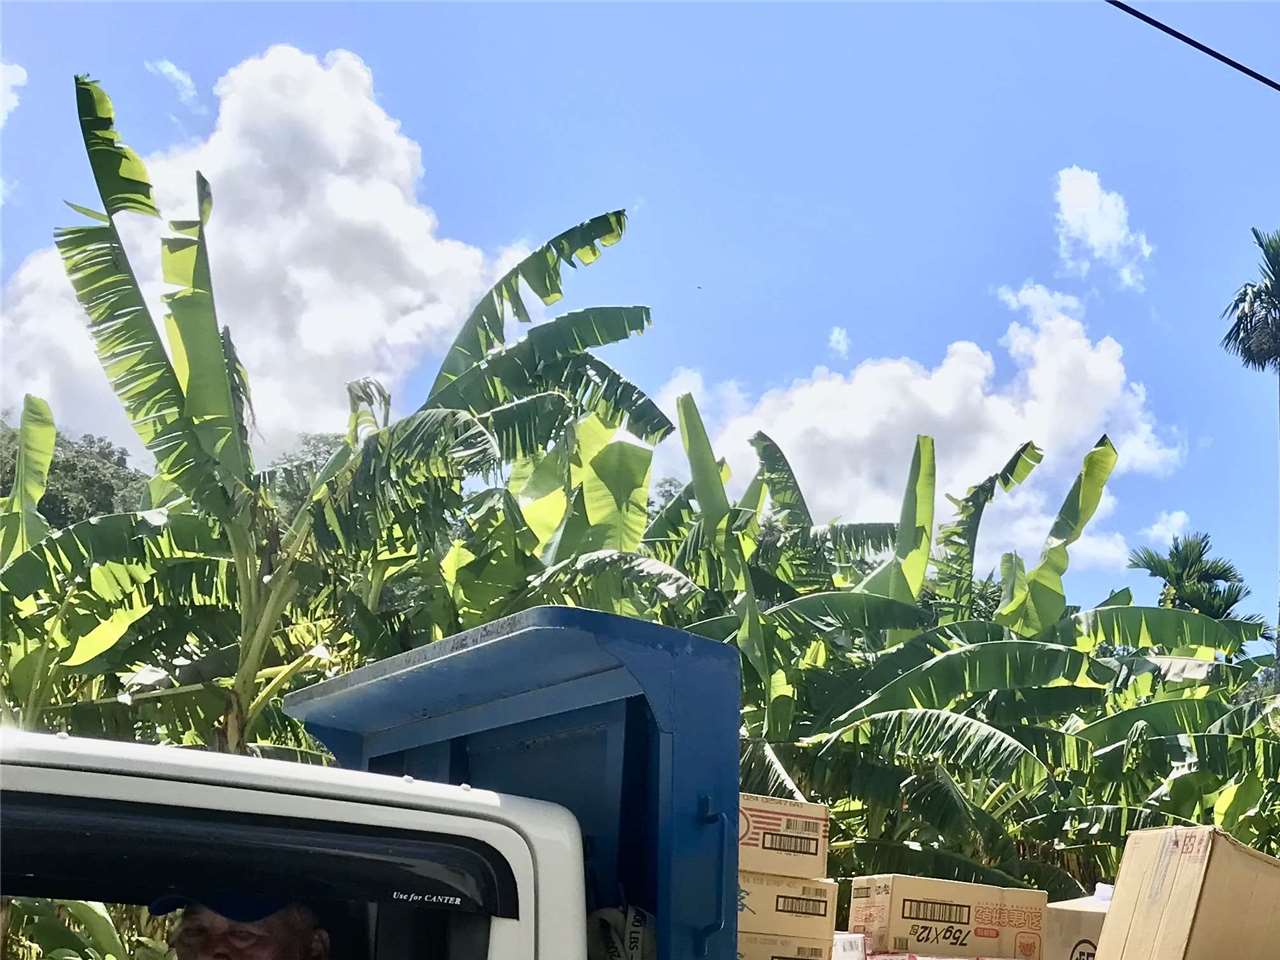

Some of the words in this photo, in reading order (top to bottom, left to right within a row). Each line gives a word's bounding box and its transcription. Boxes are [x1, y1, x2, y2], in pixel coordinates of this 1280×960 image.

[392, 891, 409, 900] Use
[408, 892, 423, 902] for
[424, 894, 462, 905] CANTER
